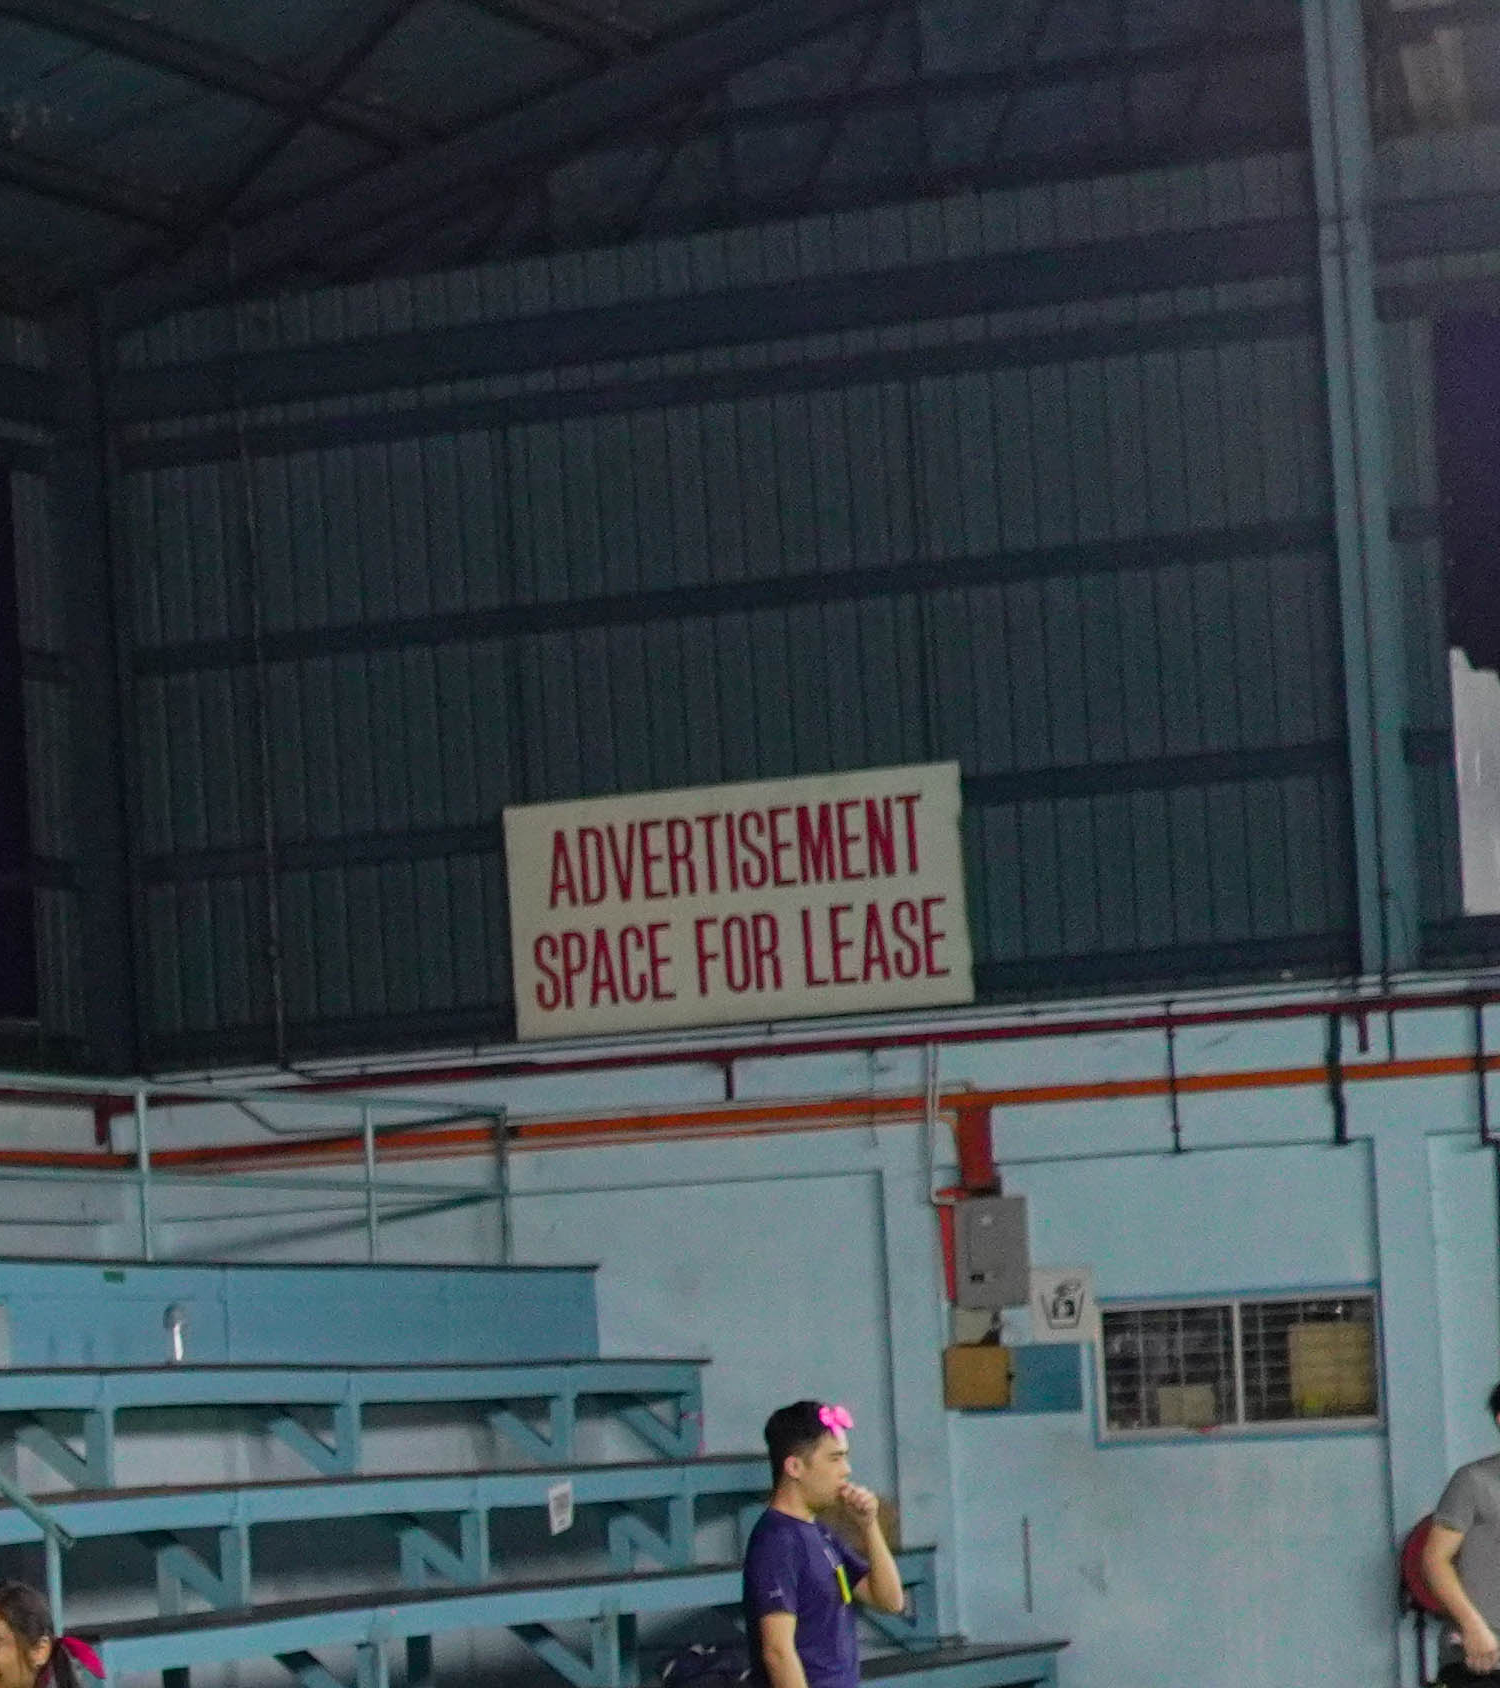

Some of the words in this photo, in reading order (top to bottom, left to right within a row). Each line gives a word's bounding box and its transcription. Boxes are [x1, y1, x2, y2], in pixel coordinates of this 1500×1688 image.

[548, 792, 923, 910] ADVERTISEMENT
[533, 921, 677, 1012] SPACE
[694, 911, 783, 1000] FOR
[801, 896, 951, 989] LEASE
